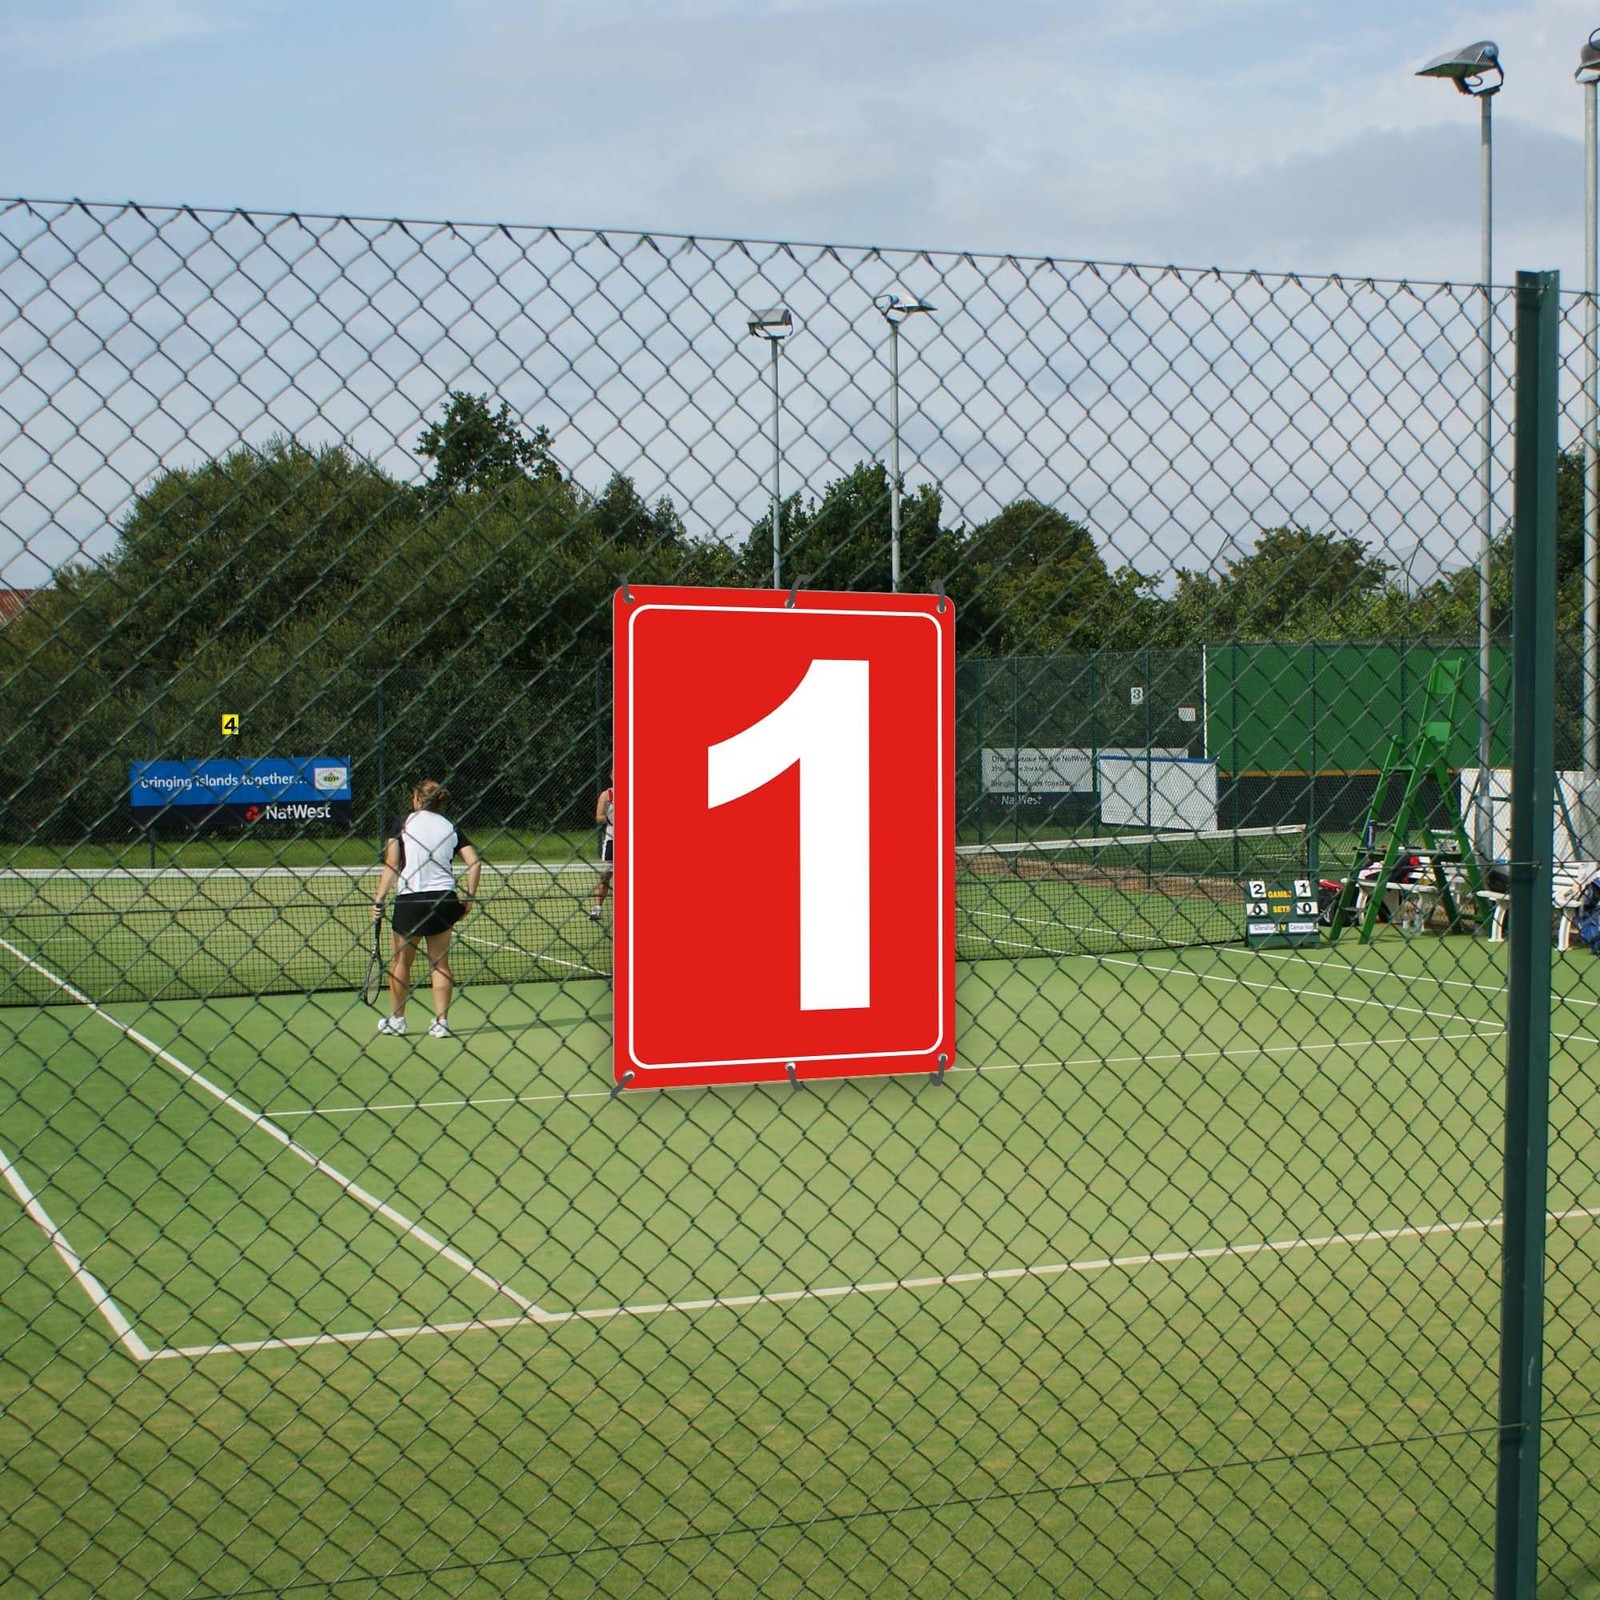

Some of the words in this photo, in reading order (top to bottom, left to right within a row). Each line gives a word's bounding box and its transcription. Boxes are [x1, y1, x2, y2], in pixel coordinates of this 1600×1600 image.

[1133, 689, 1141, 700] 3
[224, 717, 237, 732] 4
[195, 773, 239, 787] islands
[265, 804, 332, 820] NatWest
[707, 658, 871, 1012] 1
[1253, 884, 1264, 895] 2
[1300, 883, 1308, 894] 1
[1253, 904, 1262, 915] 0
[1273, 905, 1291, 913] SETS
[1303, 903, 1312, 913] 0
